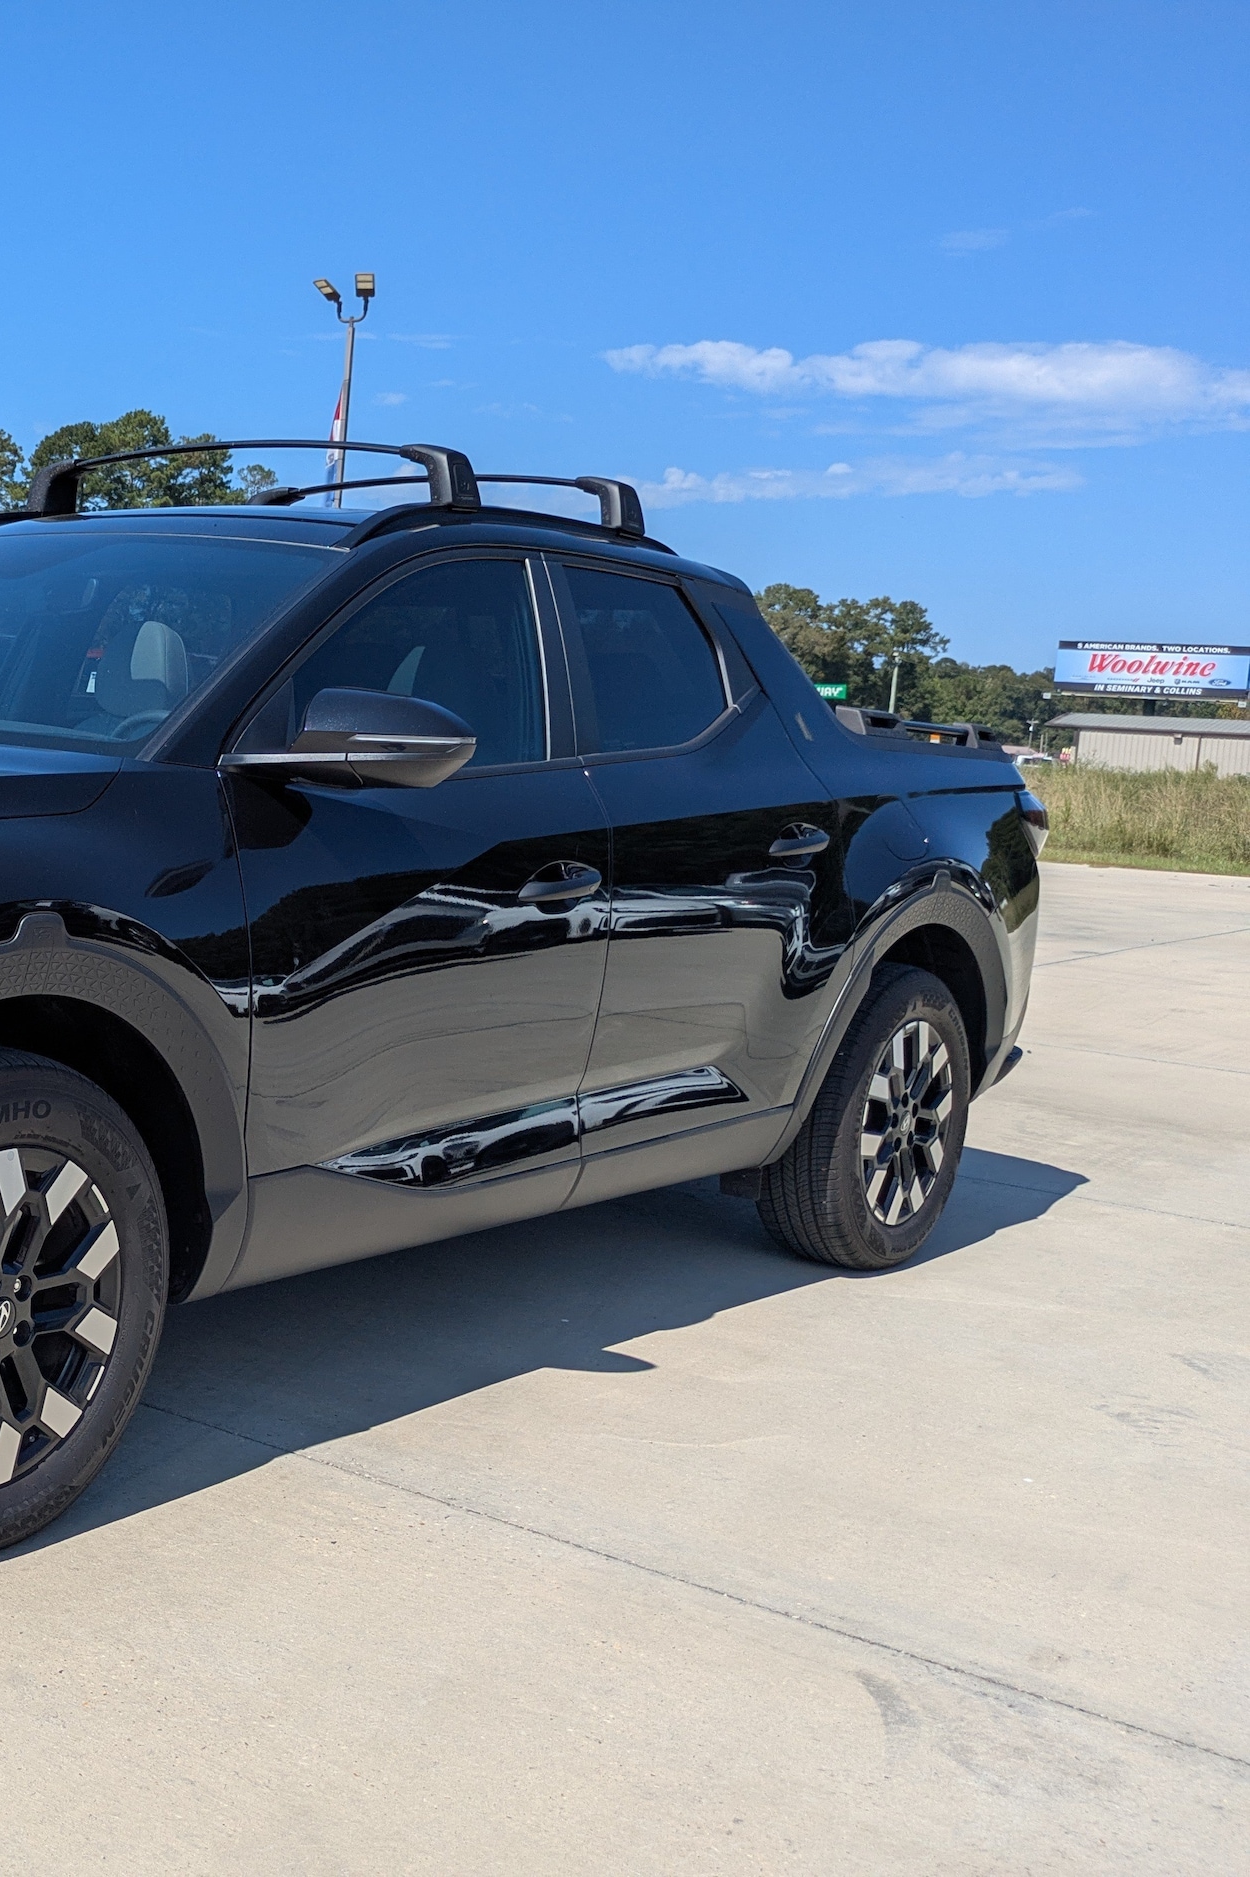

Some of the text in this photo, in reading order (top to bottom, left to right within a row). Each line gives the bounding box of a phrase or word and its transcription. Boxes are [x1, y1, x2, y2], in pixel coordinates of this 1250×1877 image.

[1083, 643, 1124, 651] AMERICAN
[1125, 644, 1159, 652] BRANDS.
[1182, 646, 1231, 654] LOCATIONS.
[1088, 653, 1216, 677] Woolwine
[1147, 677, 1165, 685] Jeep
[1210, 679, 1229, 687] Ford
[1094, 683, 1203, 696] IN SEMINARY & COLLINS
